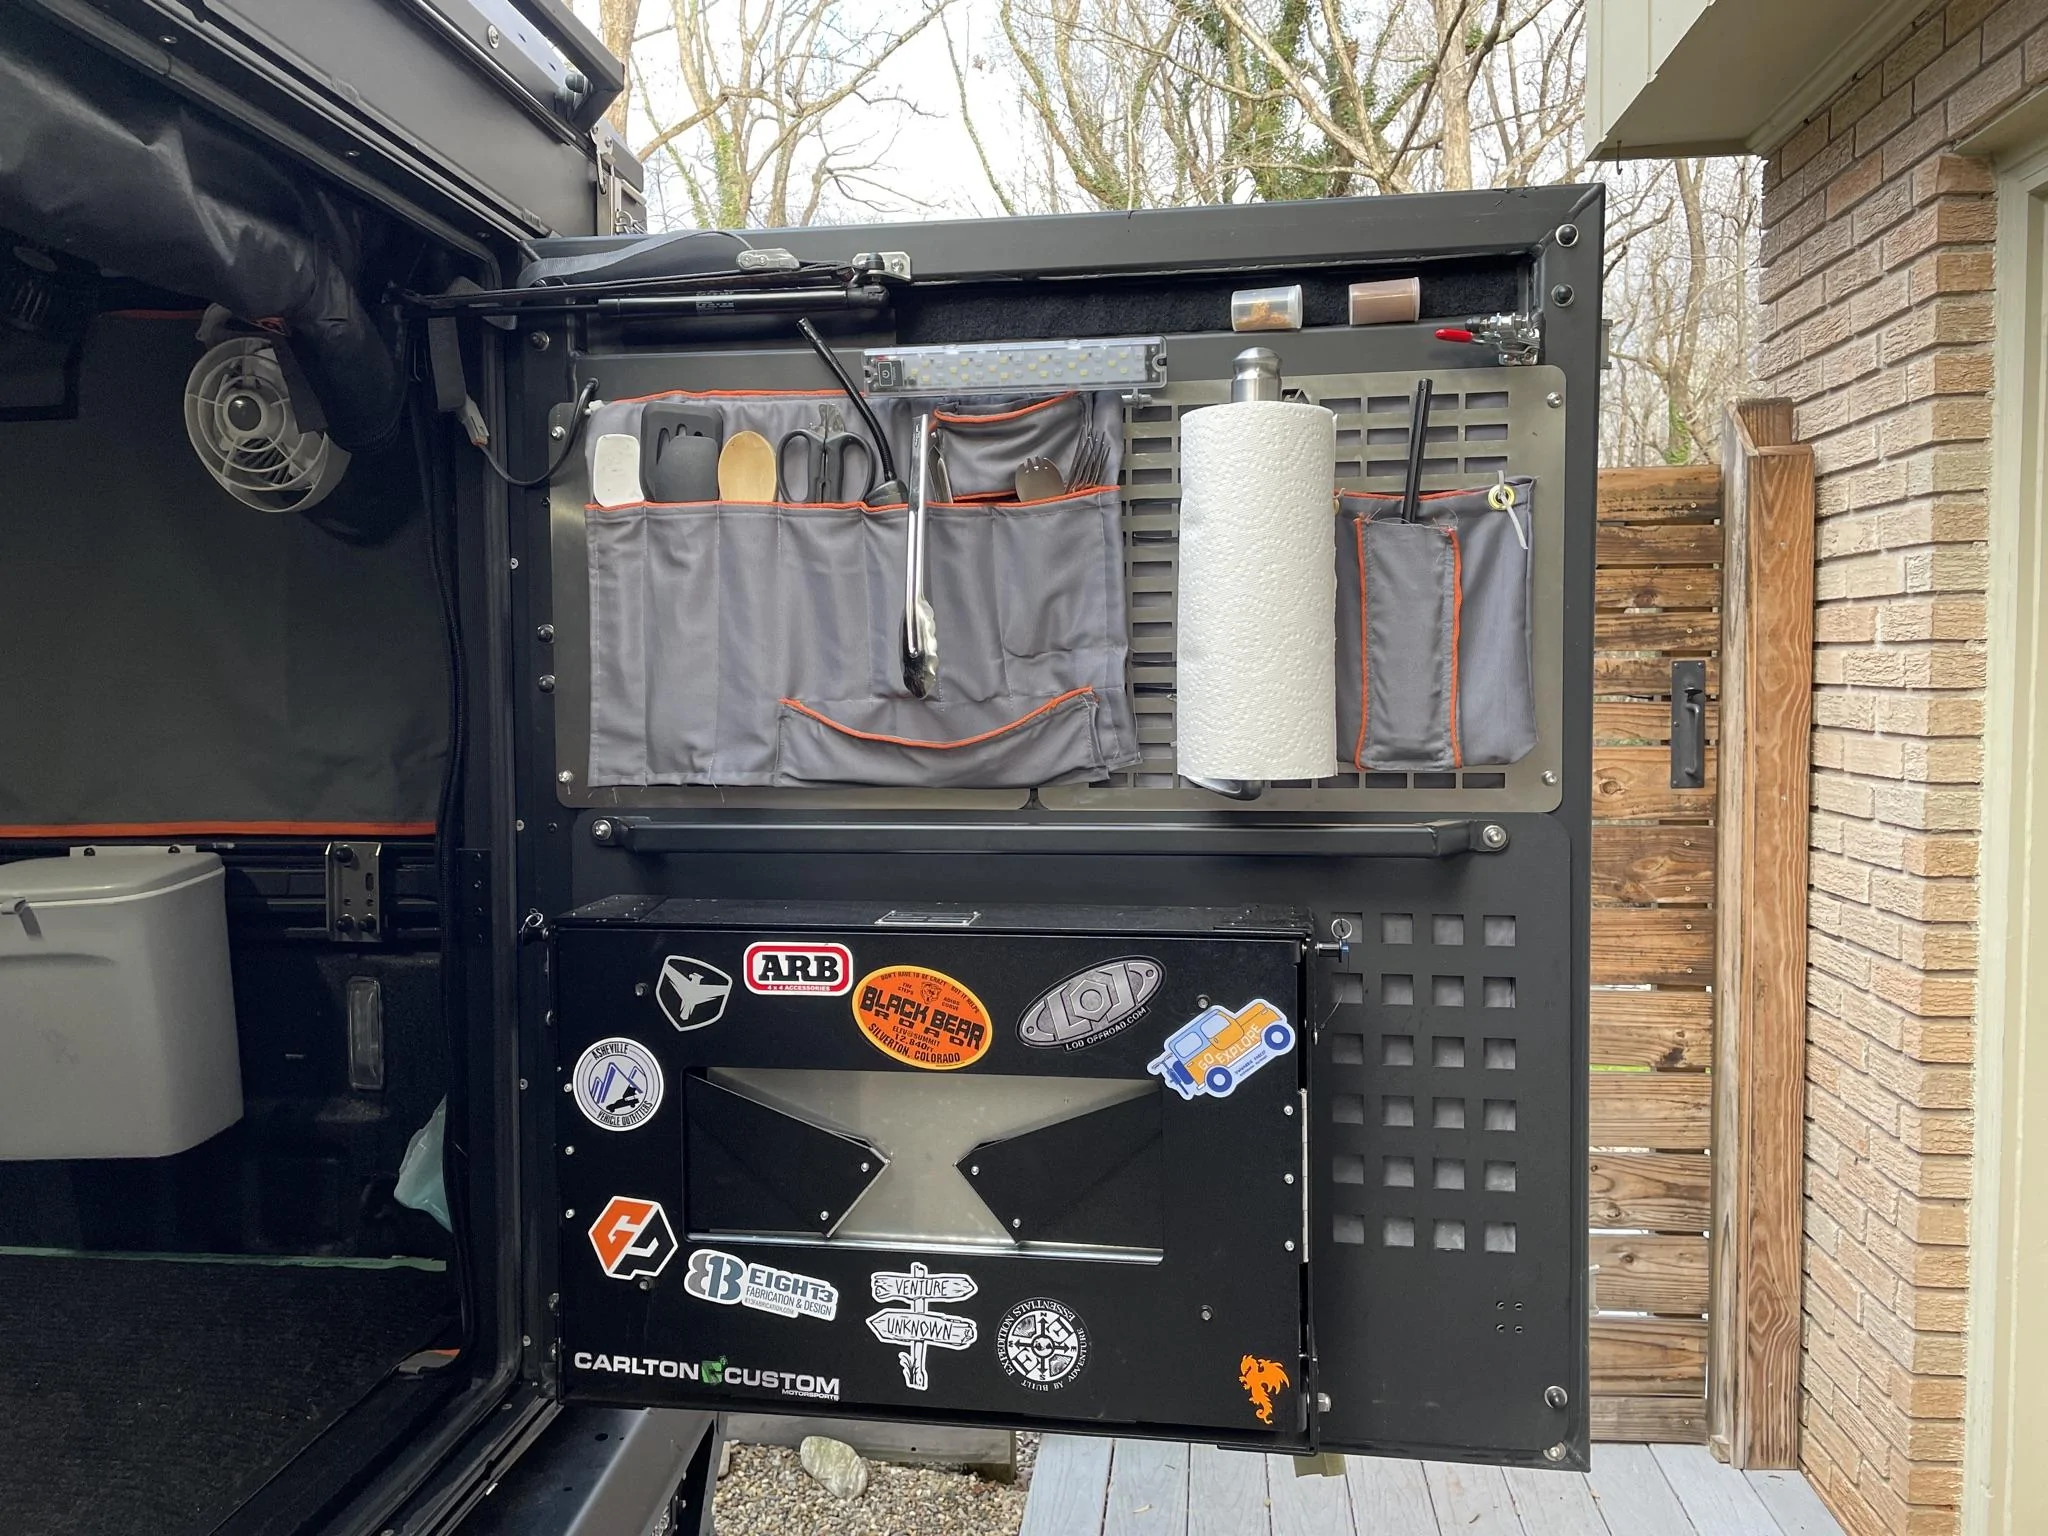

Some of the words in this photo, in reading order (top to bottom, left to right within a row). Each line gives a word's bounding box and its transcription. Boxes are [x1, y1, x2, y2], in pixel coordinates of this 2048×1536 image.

[758, 954, 839, 982] ARB
[929, 974, 946, 986] CRAZY
[951, 986, 961, 995] BUT
[966, 998, 980, 1014] HELPS
[860, 985, 929, 1024] BLACK
[930, 1009, 985, 1050] BEAR
[1065, 1040, 1085, 1051] LOD
[1086, 1008, 1147, 1045] OFFROAD.COM
[592, 1044, 629, 1061] ASHEVILLE
[914, 1050, 961, 1064] COLORADO
[1198, 1052, 1215, 1071] GO
[1216, 1023, 1262, 1064] EXPLORE
[597, 1110, 620, 1126] VEHICLE
[622, 1100, 653, 1126] OUTFITTERS
[746, 1285, 795, 1307] FABRICATION
[795, 1298, 802, 1309] &
[804, 1300, 832, 1316] DESIGN
[895, 1277, 950, 1297] VENTURE
[887, 1316, 953, 1340] UNKNOWN
[997, 1315, 1016, 1376] EXPEDITION
[1013, 1300, 1076, 1322] ESSENTIALS
[574, 1352, 699, 1380] CARLTON
[724, 1367, 840, 1395] CUSTOM
[1020, 1379, 1049, 1391] BUILT
[1053, 1381, 1064, 1390] BY
[1068, 1327, 1088, 1382] ADVENTURE
[781, 1388, 840, 1401] MOTORSPORTS
